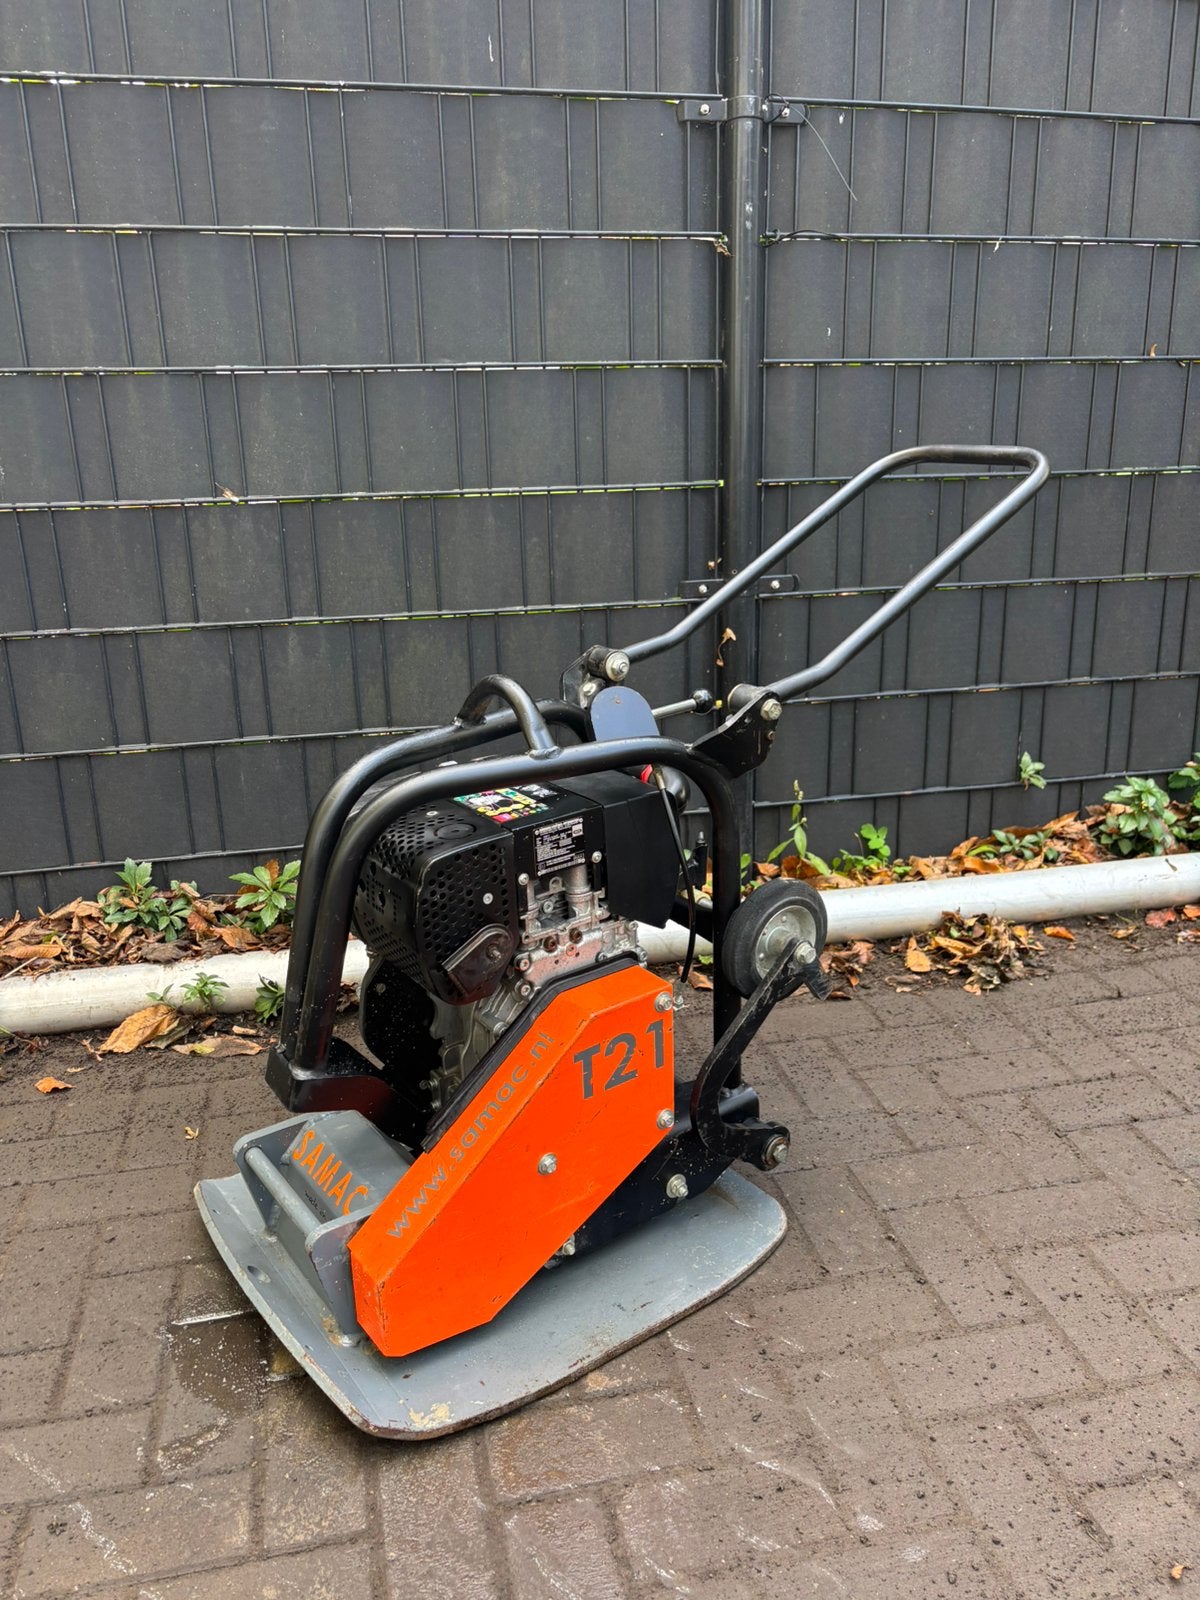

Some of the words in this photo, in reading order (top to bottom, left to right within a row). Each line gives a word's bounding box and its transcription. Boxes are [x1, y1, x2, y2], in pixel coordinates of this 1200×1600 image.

[573, 1019, 666, 1100] T21
[292, 1129, 369, 1216] SAMAC
[386, 1031, 556, 1239] www.samac.nl
